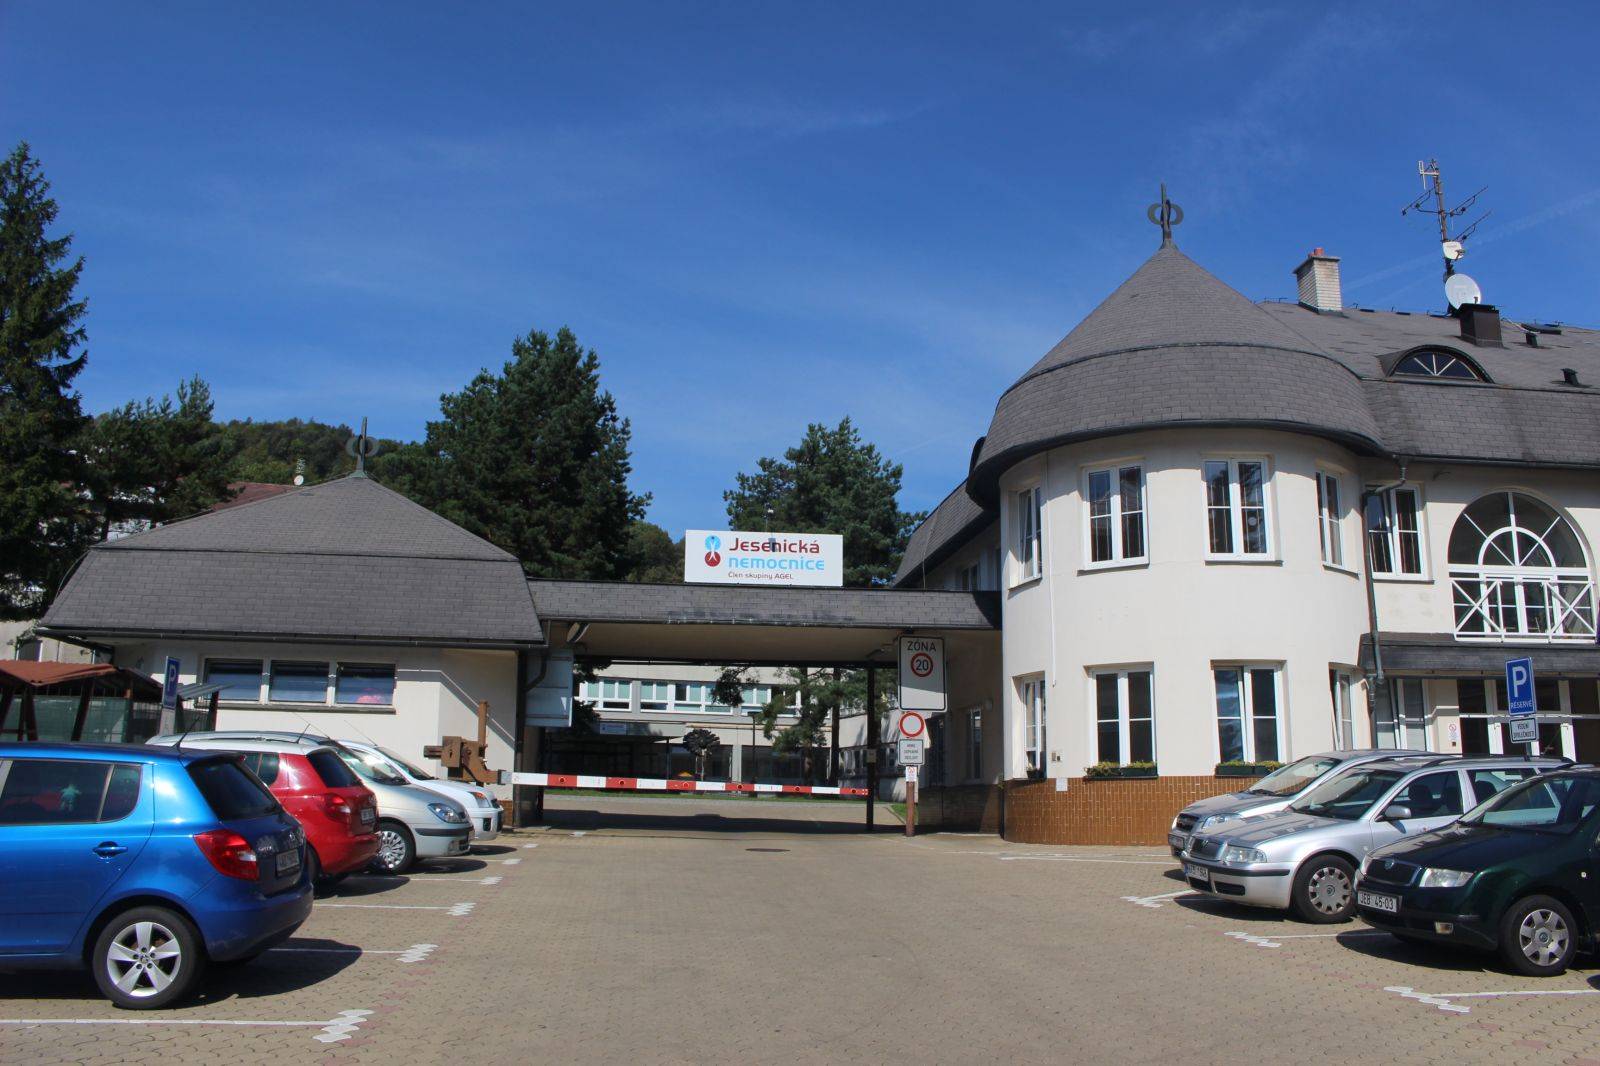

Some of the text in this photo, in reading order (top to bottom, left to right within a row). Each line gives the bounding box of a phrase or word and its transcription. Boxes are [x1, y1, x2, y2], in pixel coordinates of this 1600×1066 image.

[729, 538, 820, 553] Jesenická
[745, 571, 773, 580] skupiny
[774, 572, 794, 580] AGEL
[907, 639, 937, 652] ZÓNA
[915, 659, 929, 671] 20
[168, 664, 177, 692] P
[1512, 666, 1527, 697] P
